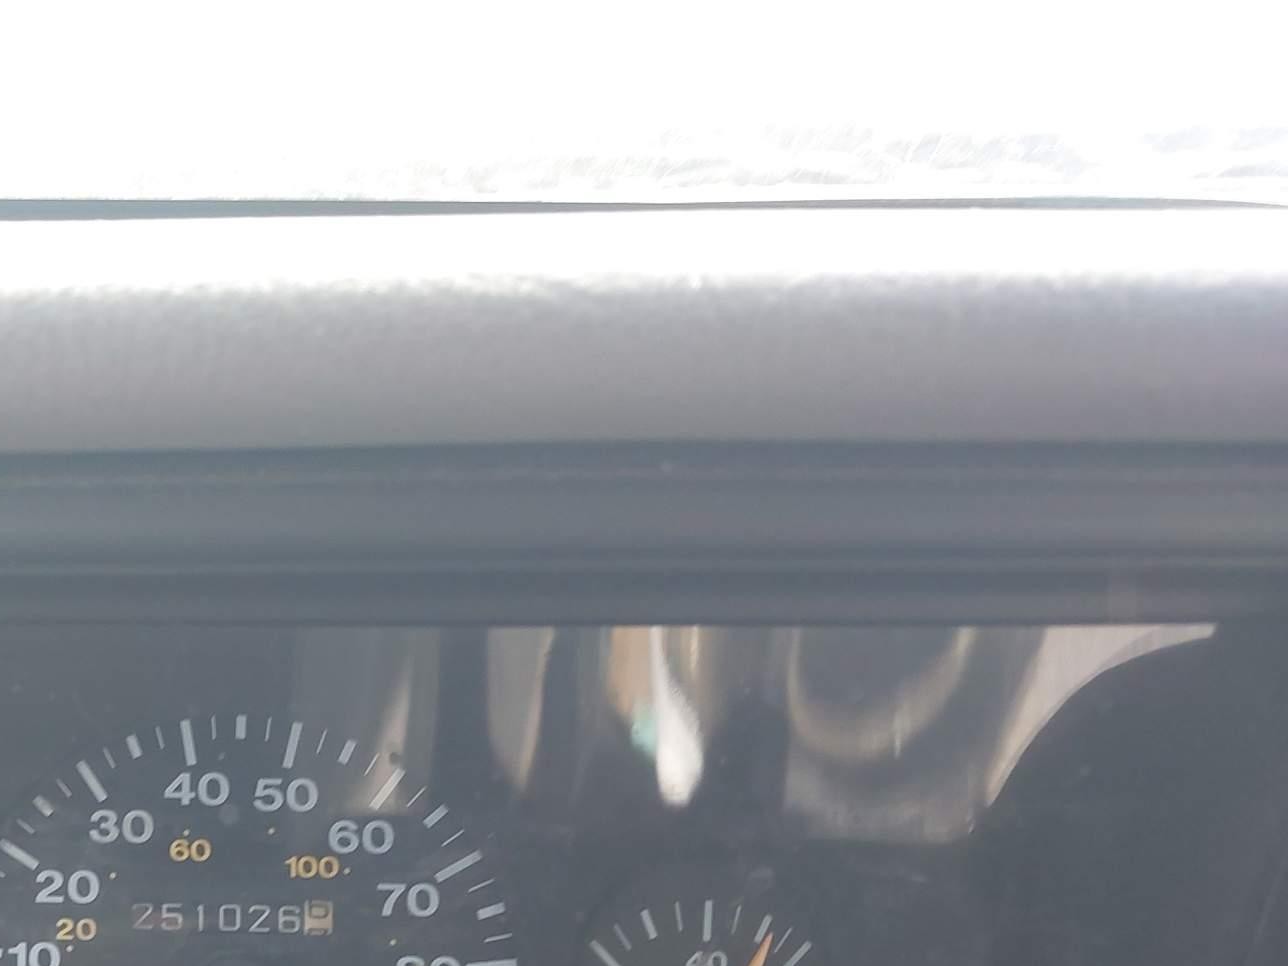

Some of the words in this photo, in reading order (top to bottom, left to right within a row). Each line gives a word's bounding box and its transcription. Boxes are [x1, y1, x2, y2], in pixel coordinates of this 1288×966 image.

[164, 772, 229, 806] 40
[253, 778, 318, 811] 50
[89, 810, 154, 844] 30
[328, 820, 394, 854] 60
[169, 839, 211, 862] 60
[284, 856, 339, 879] 100
[35, 870, 100, 904] 20
[376, 882, 440, 918] 70
[56, 918, 97, 940] 20
